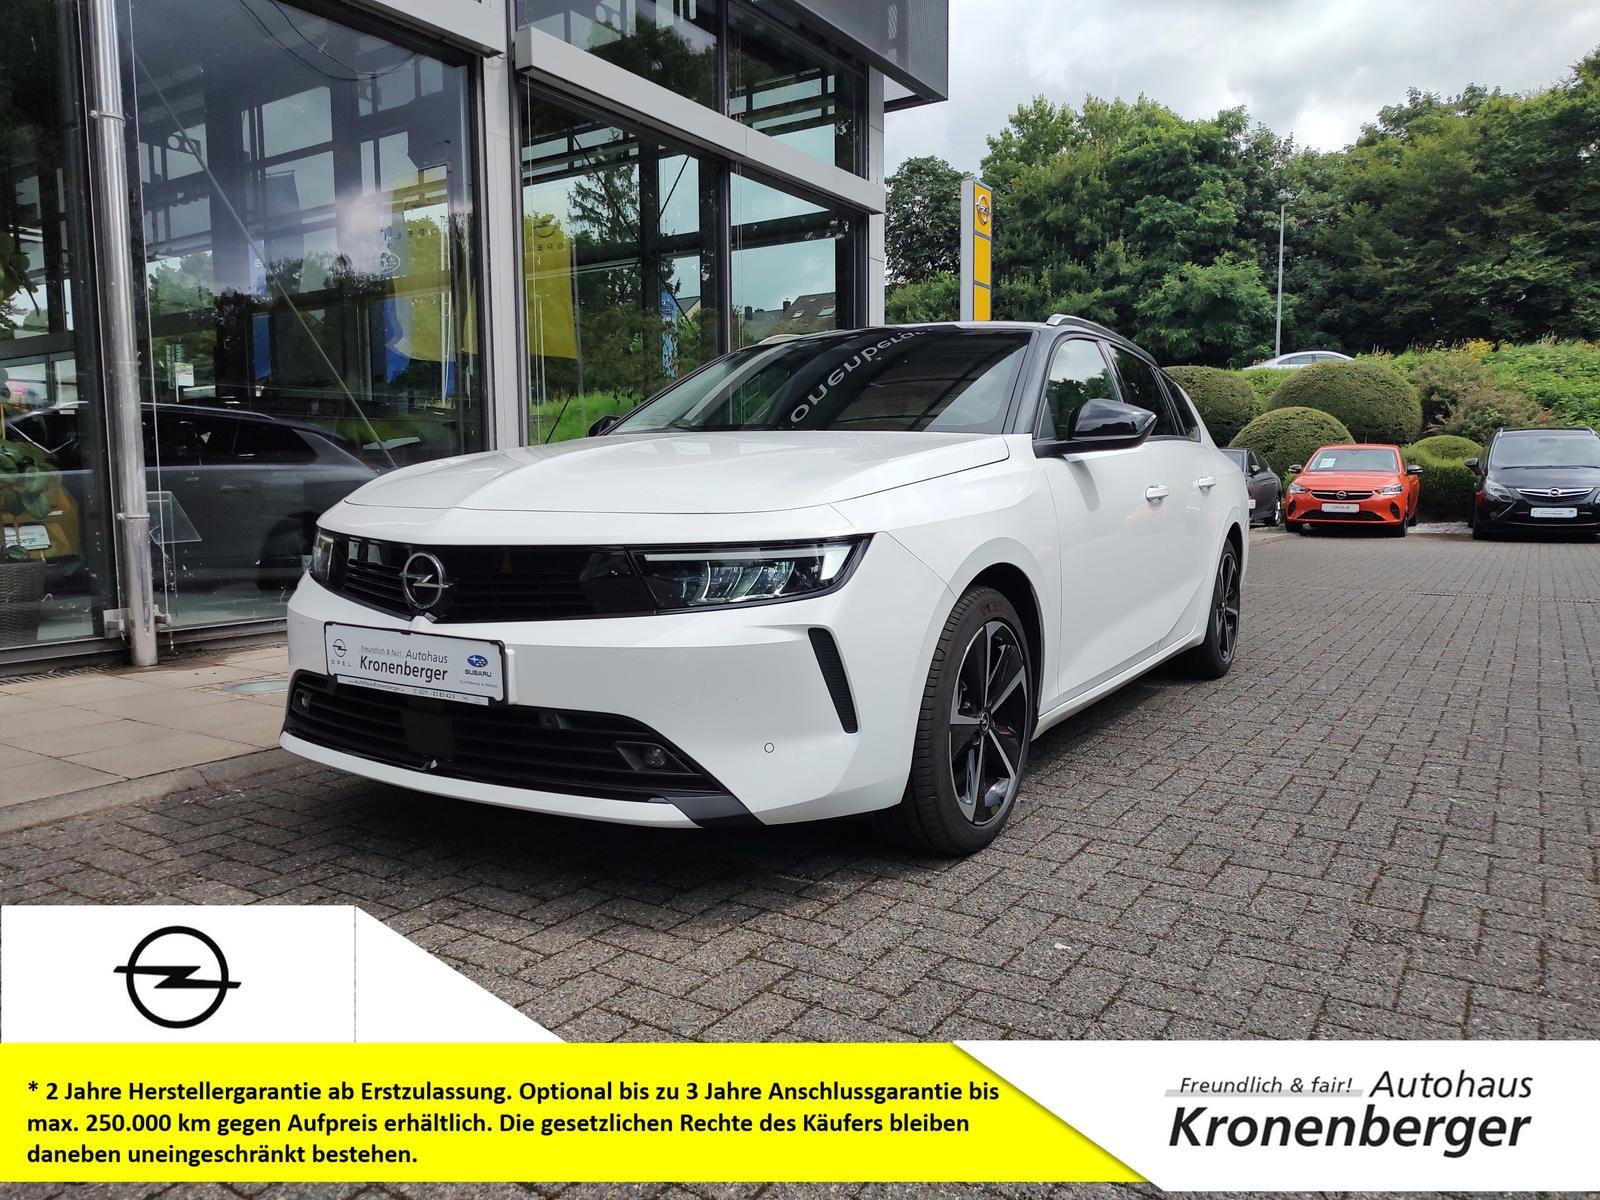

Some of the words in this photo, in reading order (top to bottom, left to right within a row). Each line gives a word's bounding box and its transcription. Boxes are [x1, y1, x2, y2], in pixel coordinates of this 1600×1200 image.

[405, 649, 449, 664] Autohaus
[330, 659, 352, 668] OPEL
[360, 655, 448, 683] Kronenberger
[464, 668, 492, 678] SUBARU
